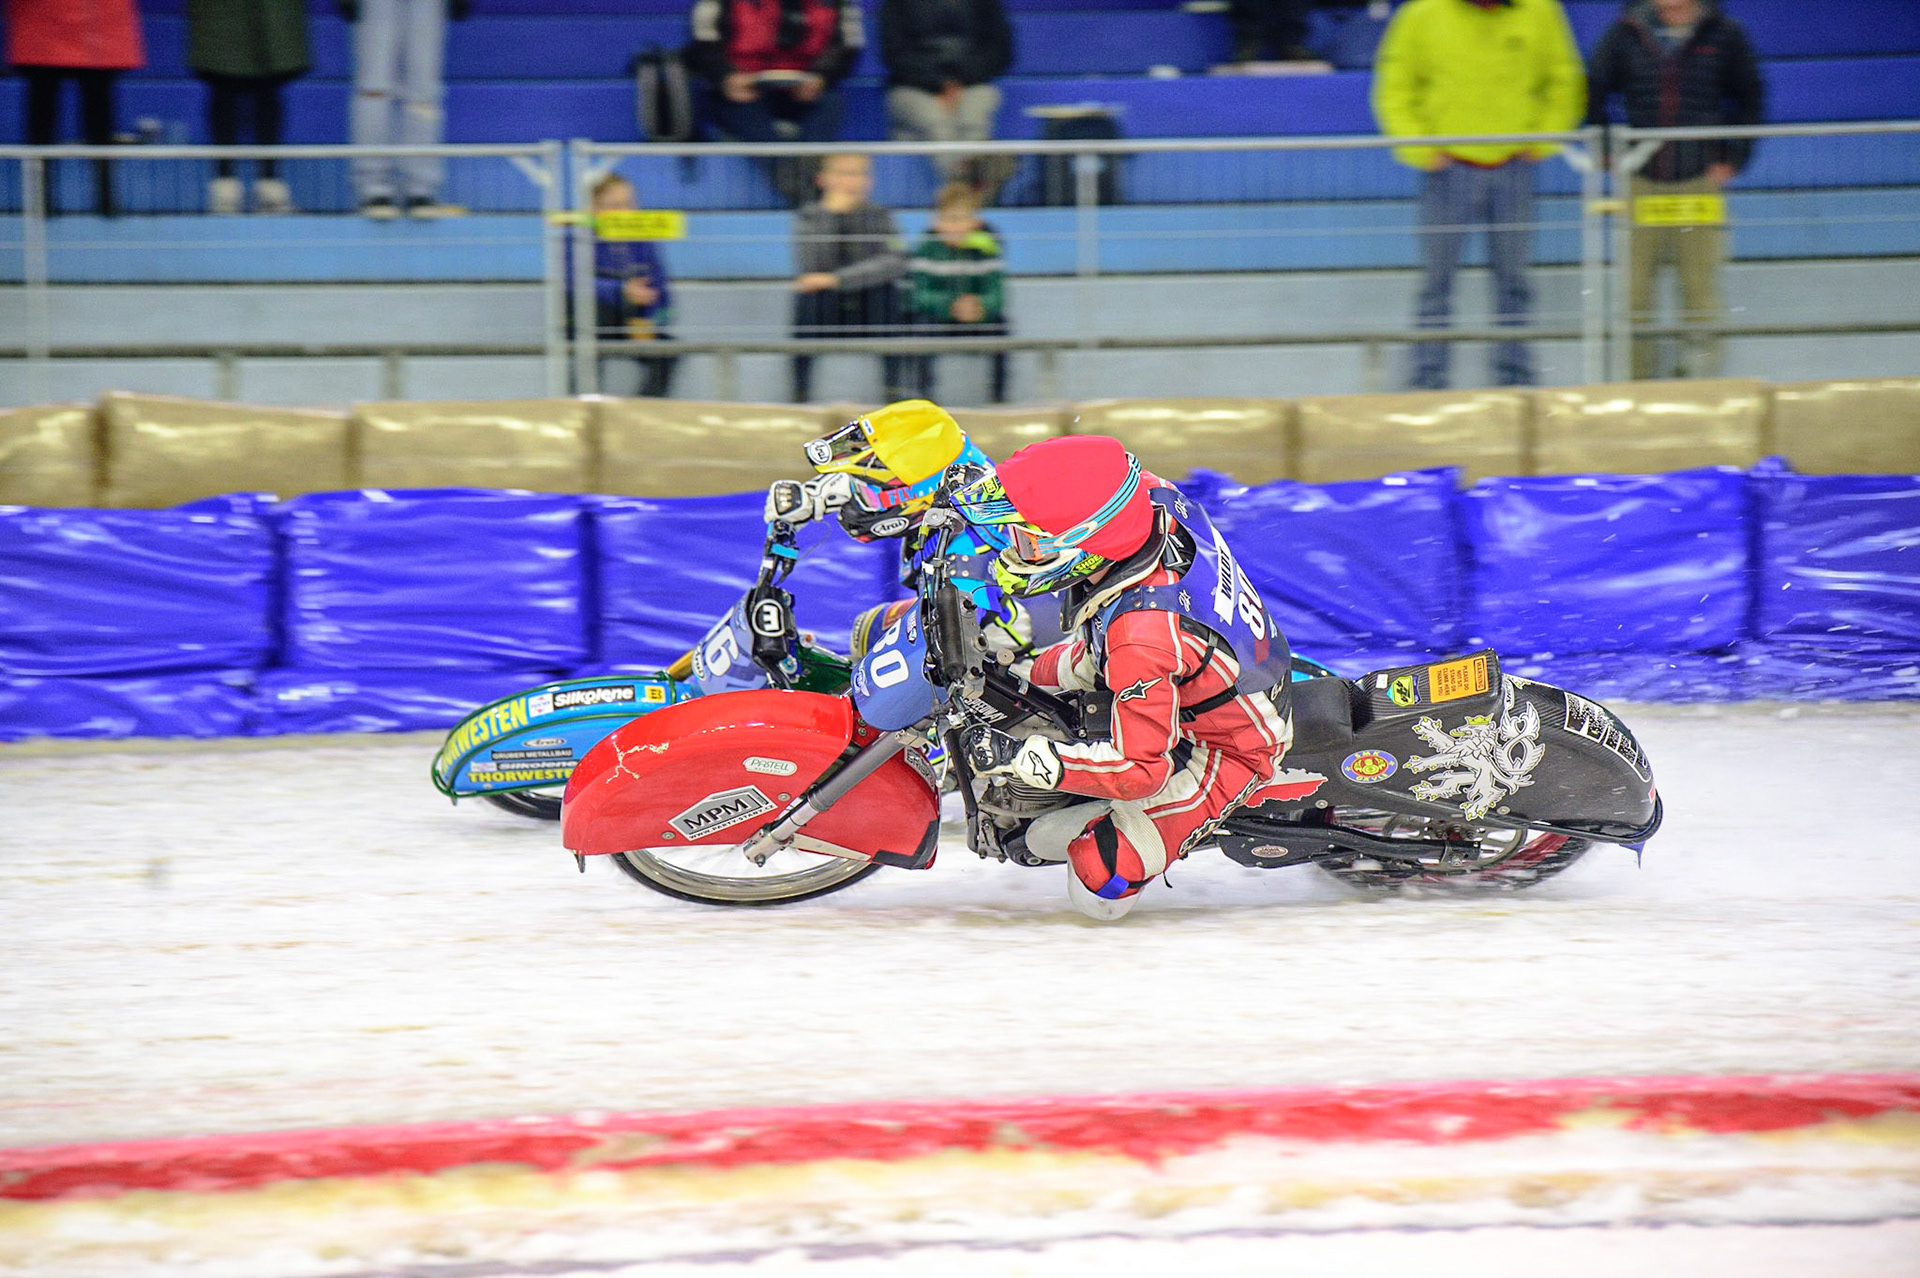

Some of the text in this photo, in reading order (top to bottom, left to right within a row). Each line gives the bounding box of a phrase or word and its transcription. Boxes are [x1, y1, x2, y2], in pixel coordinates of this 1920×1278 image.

[888, 486, 918, 506] FLY
[876, 519, 902, 532] Arai
[1220, 546, 1232, 601] WILDT
[1236, 562, 1266, 641] 80
[554, 687, 634, 706] Silkolene
[751, 759, 789, 771] PASTELL
[683, 798, 748, 829] MPM
